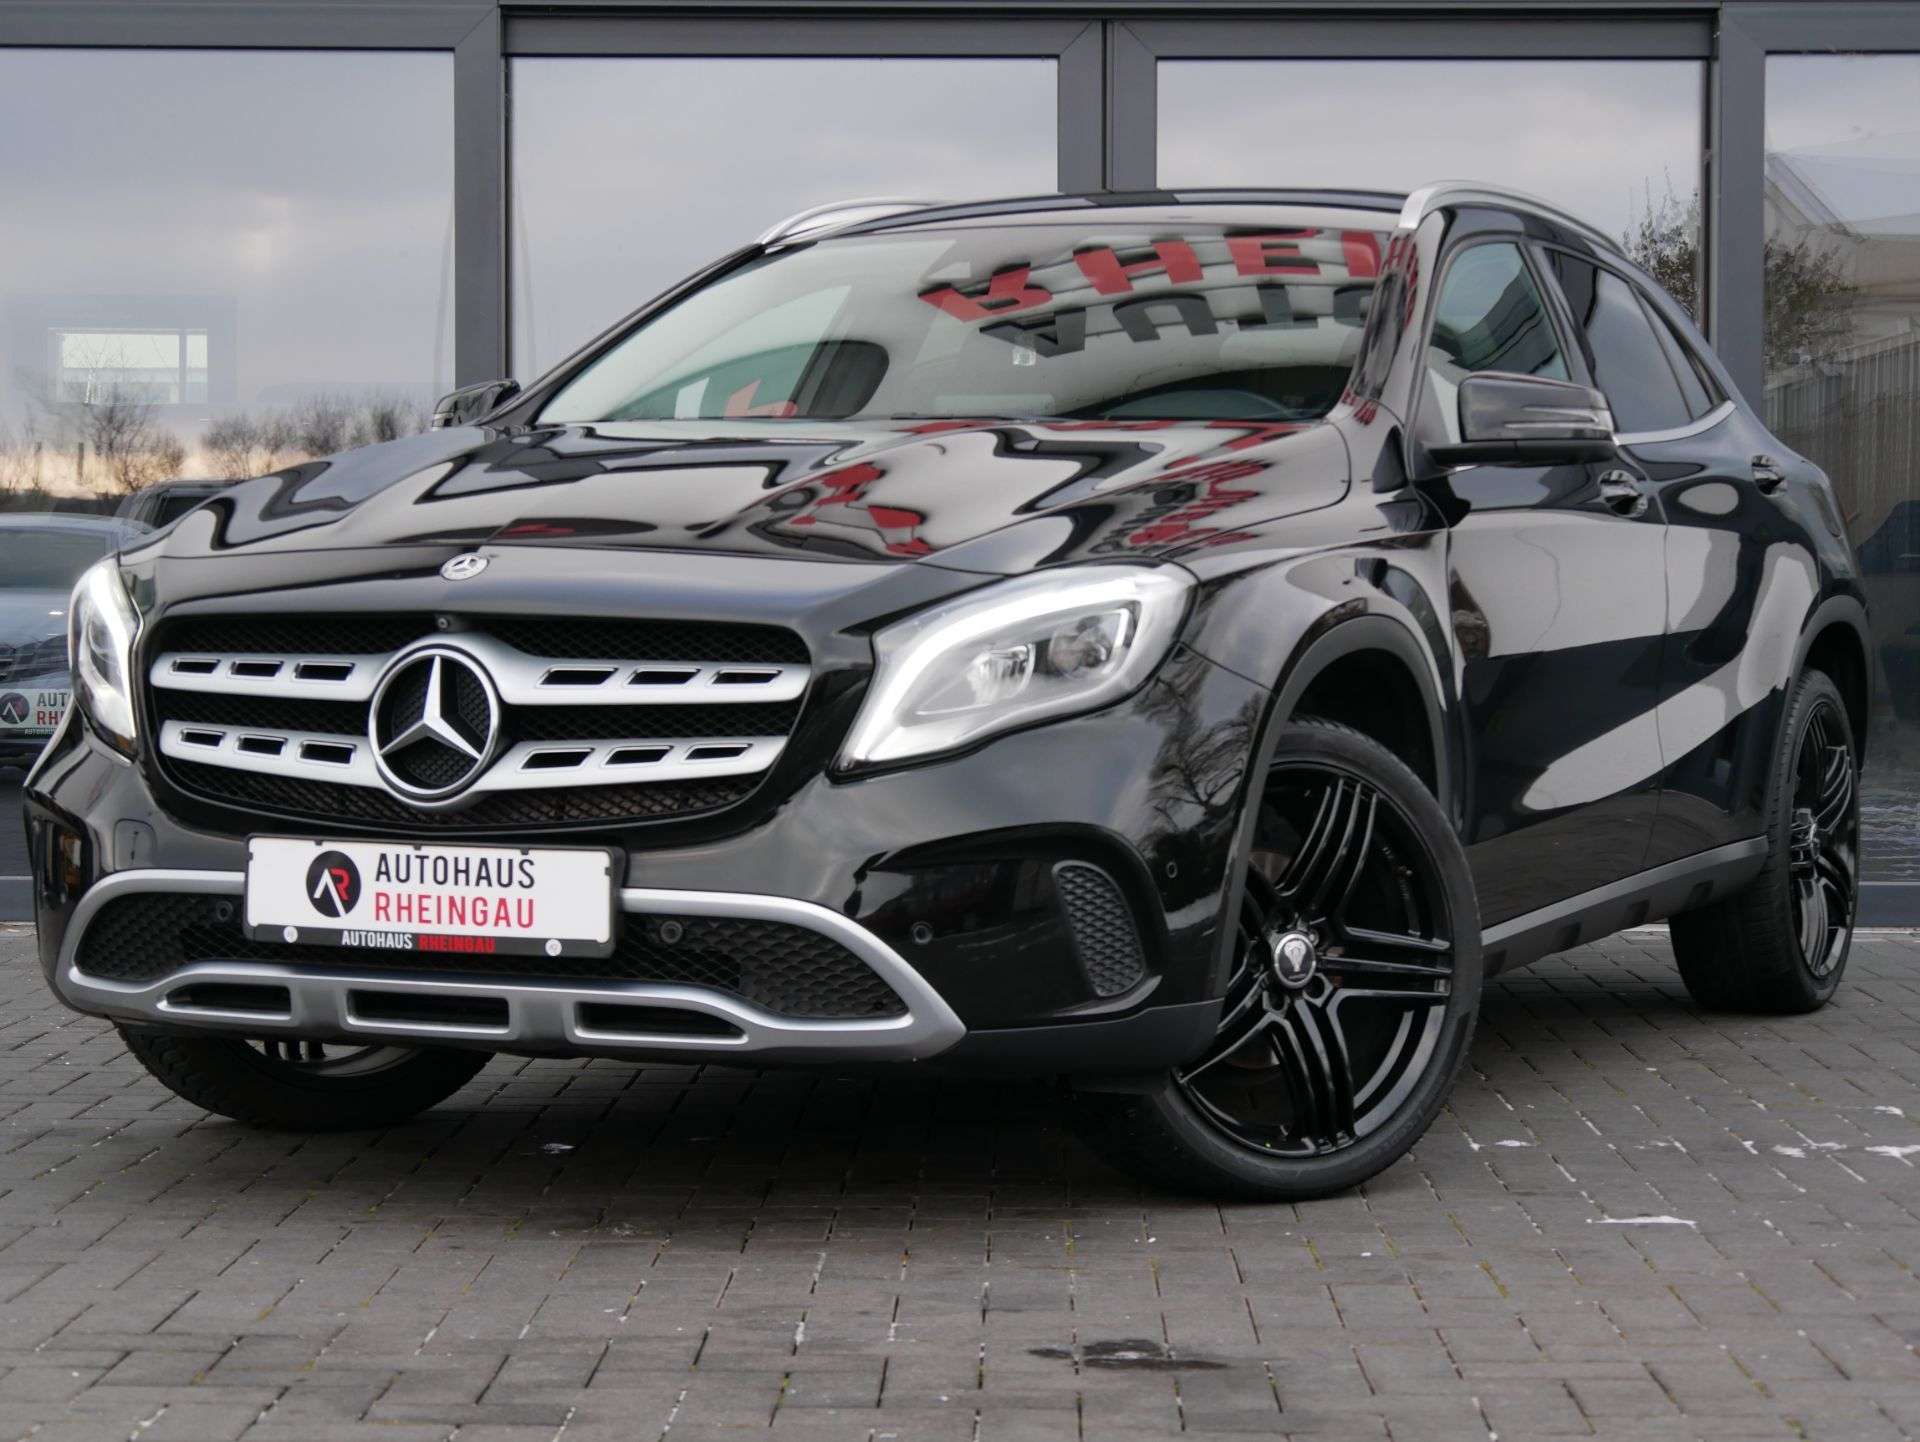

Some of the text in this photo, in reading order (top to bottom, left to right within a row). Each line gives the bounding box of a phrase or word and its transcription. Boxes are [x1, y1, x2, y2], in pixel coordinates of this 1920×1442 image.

[37, 692, 71, 707] AUT
[375, 852, 535, 889] AUTOHAUS
[375, 891, 535, 928] RHEINGAU
[340, 929, 496, 954] AUTOHAUS RHEINGAU
